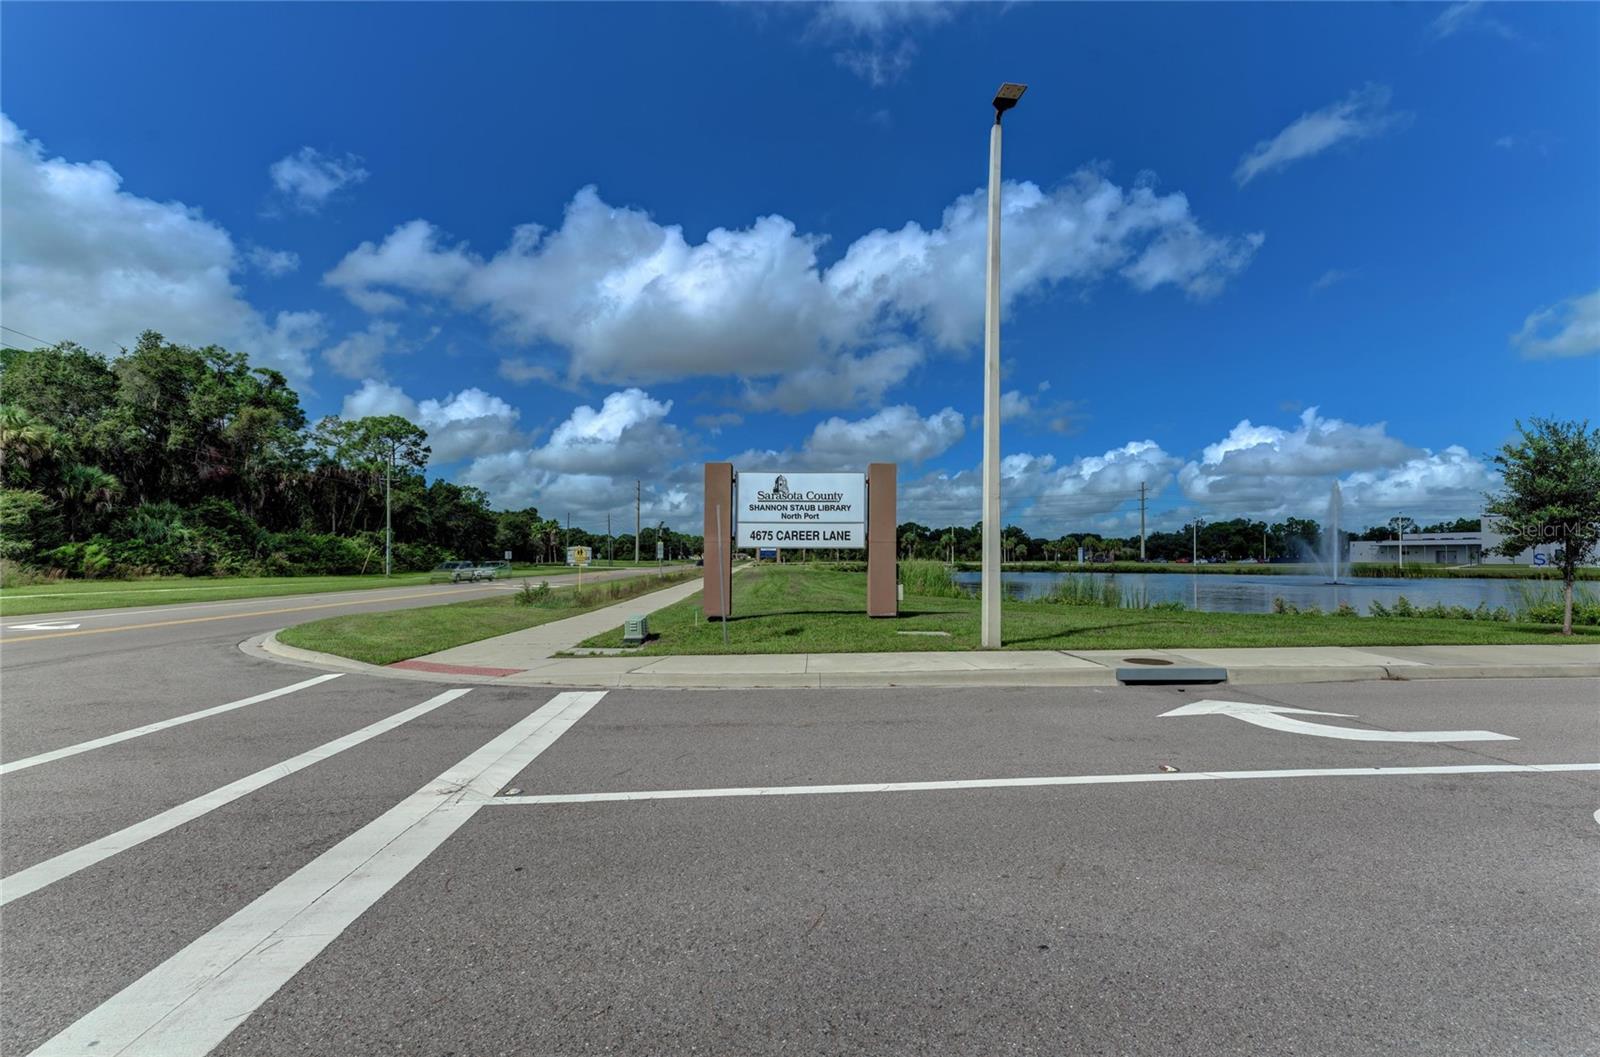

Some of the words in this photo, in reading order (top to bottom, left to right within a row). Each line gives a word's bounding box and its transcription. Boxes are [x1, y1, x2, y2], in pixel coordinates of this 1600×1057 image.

[757, 491, 803, 500] Sarasota
[806, 491, 843, 502] County
[750, 530, 773, 540] 4675
[776, 530, 819, 540] CAREER
[823, 530, 851, 540] LANE
